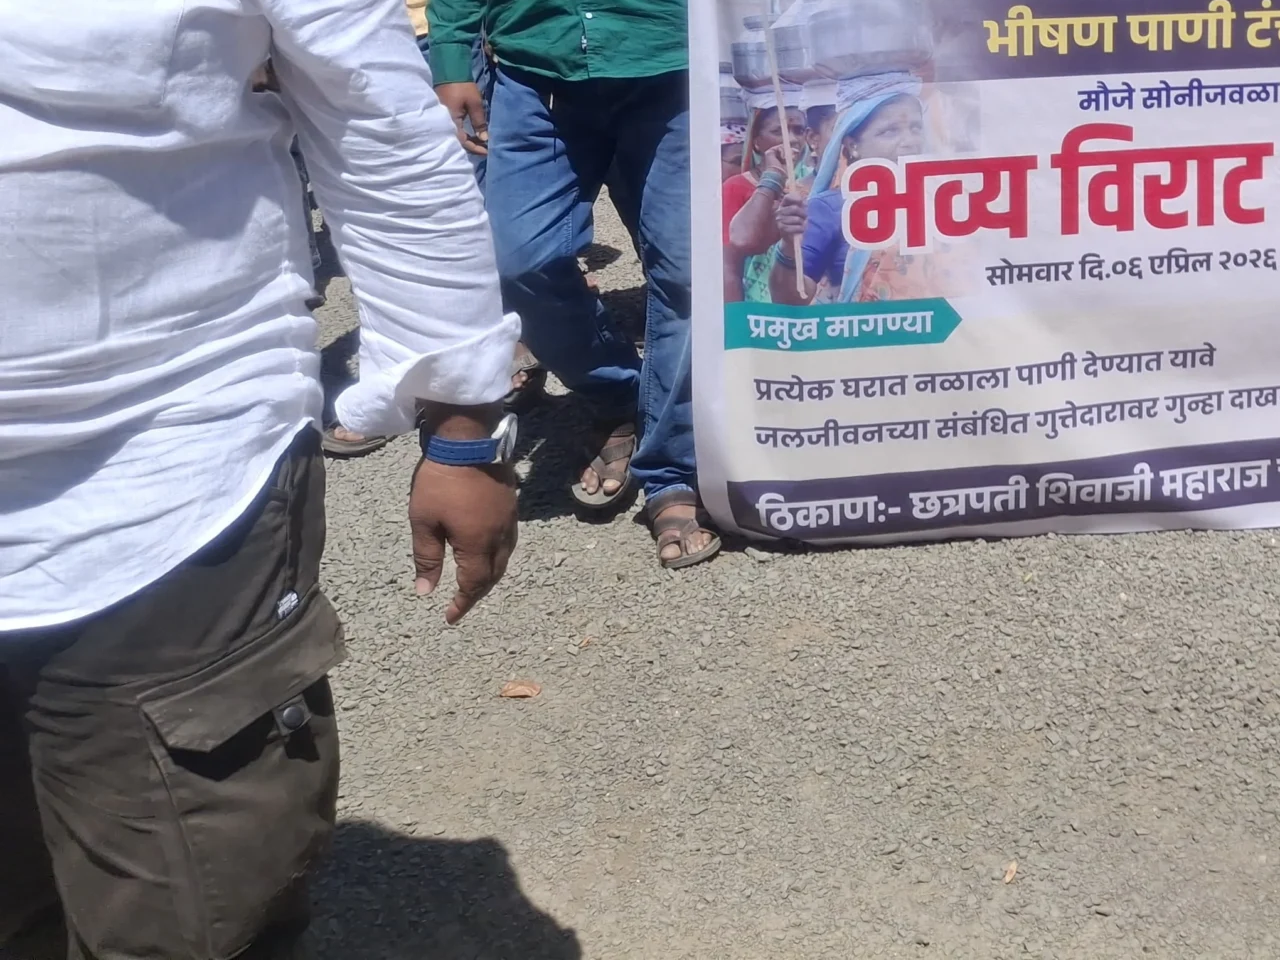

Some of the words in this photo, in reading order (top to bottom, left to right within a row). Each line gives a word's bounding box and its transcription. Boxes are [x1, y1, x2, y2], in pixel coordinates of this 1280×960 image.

[983, 5, 1118, 57] भीषण
[1077, 81, 1135, 112] मौजे
[1141, 78, 1280, 110] सोनीजवळा
[847, 153, 1038, 248] भव्य
[1051, 123, 1274, 235] विराट
[985, 248, 1074, 286] सोमवार
[1079, 243, 1143, 280] दि.०६
[1149, 247, 1213, 275] एप्रिल
[1218, 248, 1277, 271] २०२६
[747, 315, 819, 349] प्रमुख
[824, 311, 934, 339] मागण्या
[753, 375, 834, 403] प्रत्येक
[840, 375, 907, 399] घरात
[915, 367, 1009, 394] नळाला
[1016, 351, 1077, 387] पाणी
[1082, 350, 1163, 378] देण्यात
[1169, 342, 1217, 369] यावे
[754, 418, 930, 449] जलजीवनच्या
[936, 407, 1029, 440] संबंधित
[1035, 397, 1159, 439] गुत्तेदारावर
[1165, 391, 1222, 424] गुन्हा
[755, 493, 901, 532] ठिकाण:-
[910, 475, 1029, 520] छत्रपती
[1035, 463, 1153, 508] शिवाजी
[1159, 459, 1270, 503] महाराज
